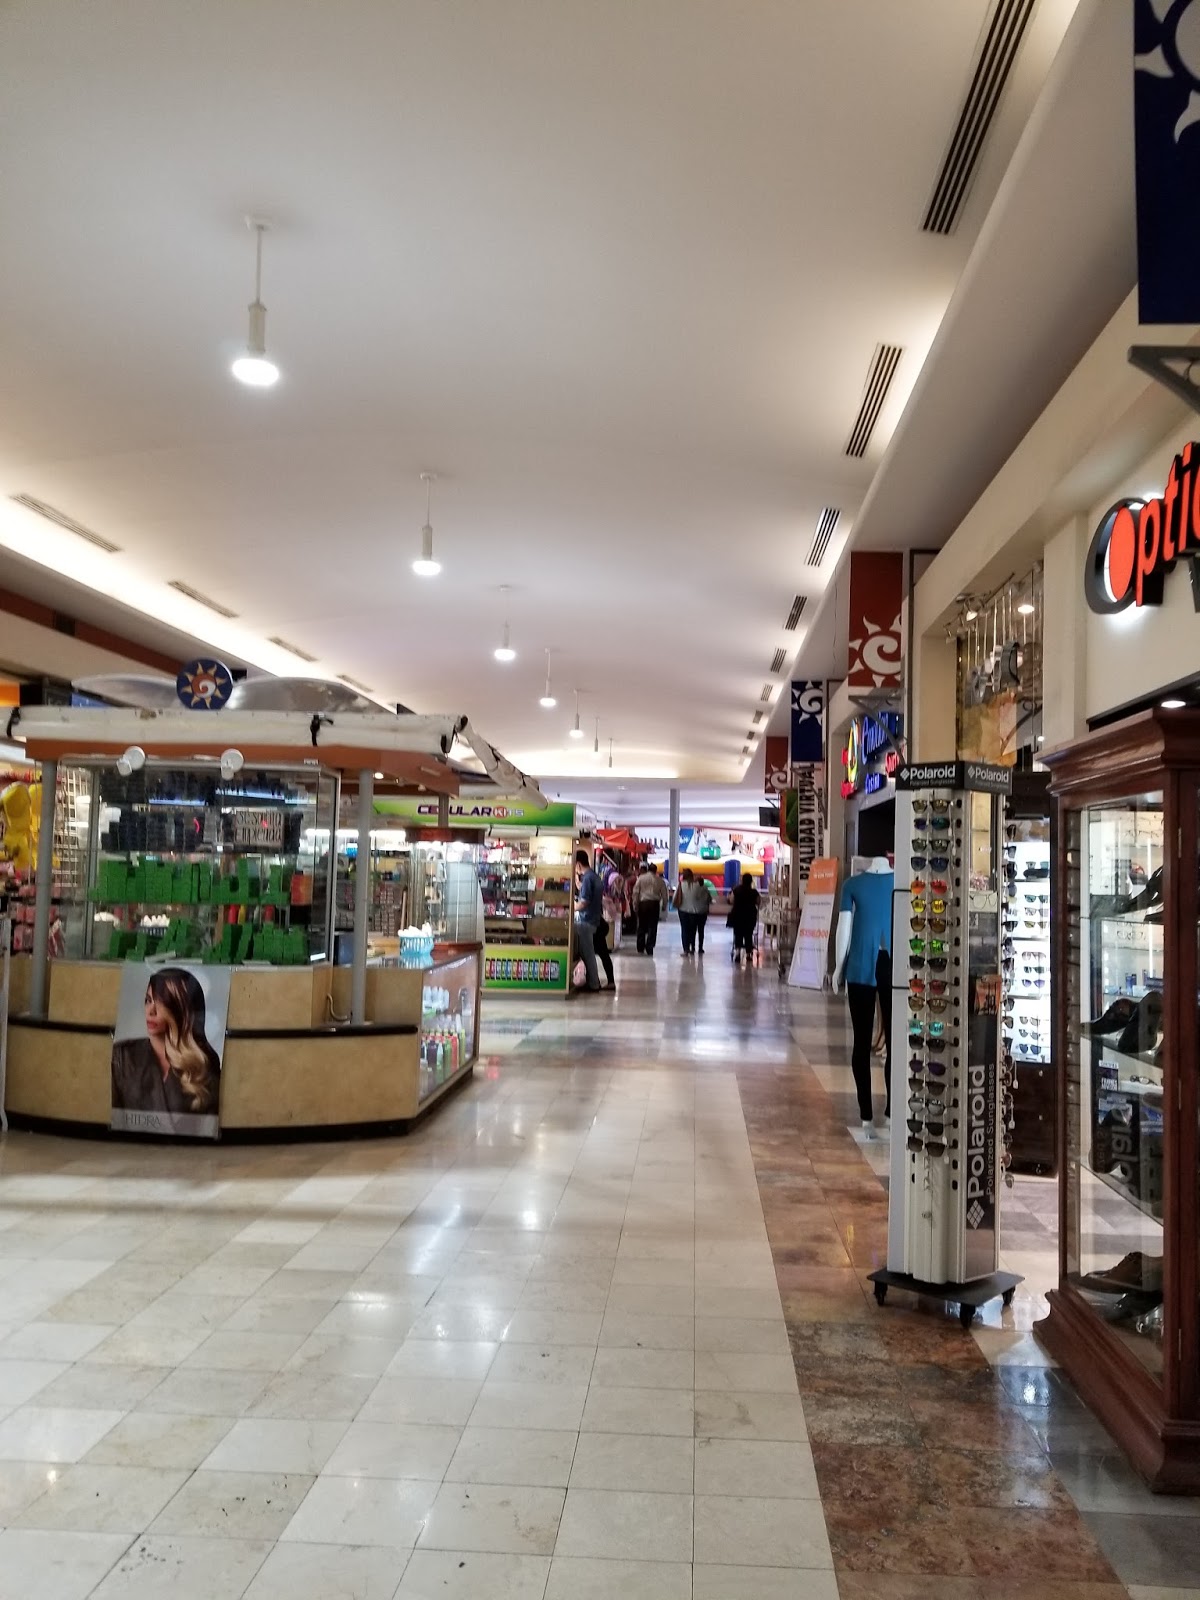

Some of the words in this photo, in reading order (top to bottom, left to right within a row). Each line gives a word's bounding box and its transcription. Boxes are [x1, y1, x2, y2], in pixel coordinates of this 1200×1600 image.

[1085, 442, 1200, 614] Opti
[910, 765, 956, 780] Polaroid
[975, 766, 1009, 783] Polaroid
[417, 804, 492, 817] CEULAR
[986, 1063, 996, 1135] Sunglasses
[967, 1064, 986, 1199] Polaroid
[986, 1139, 994, 1196] Polarized
